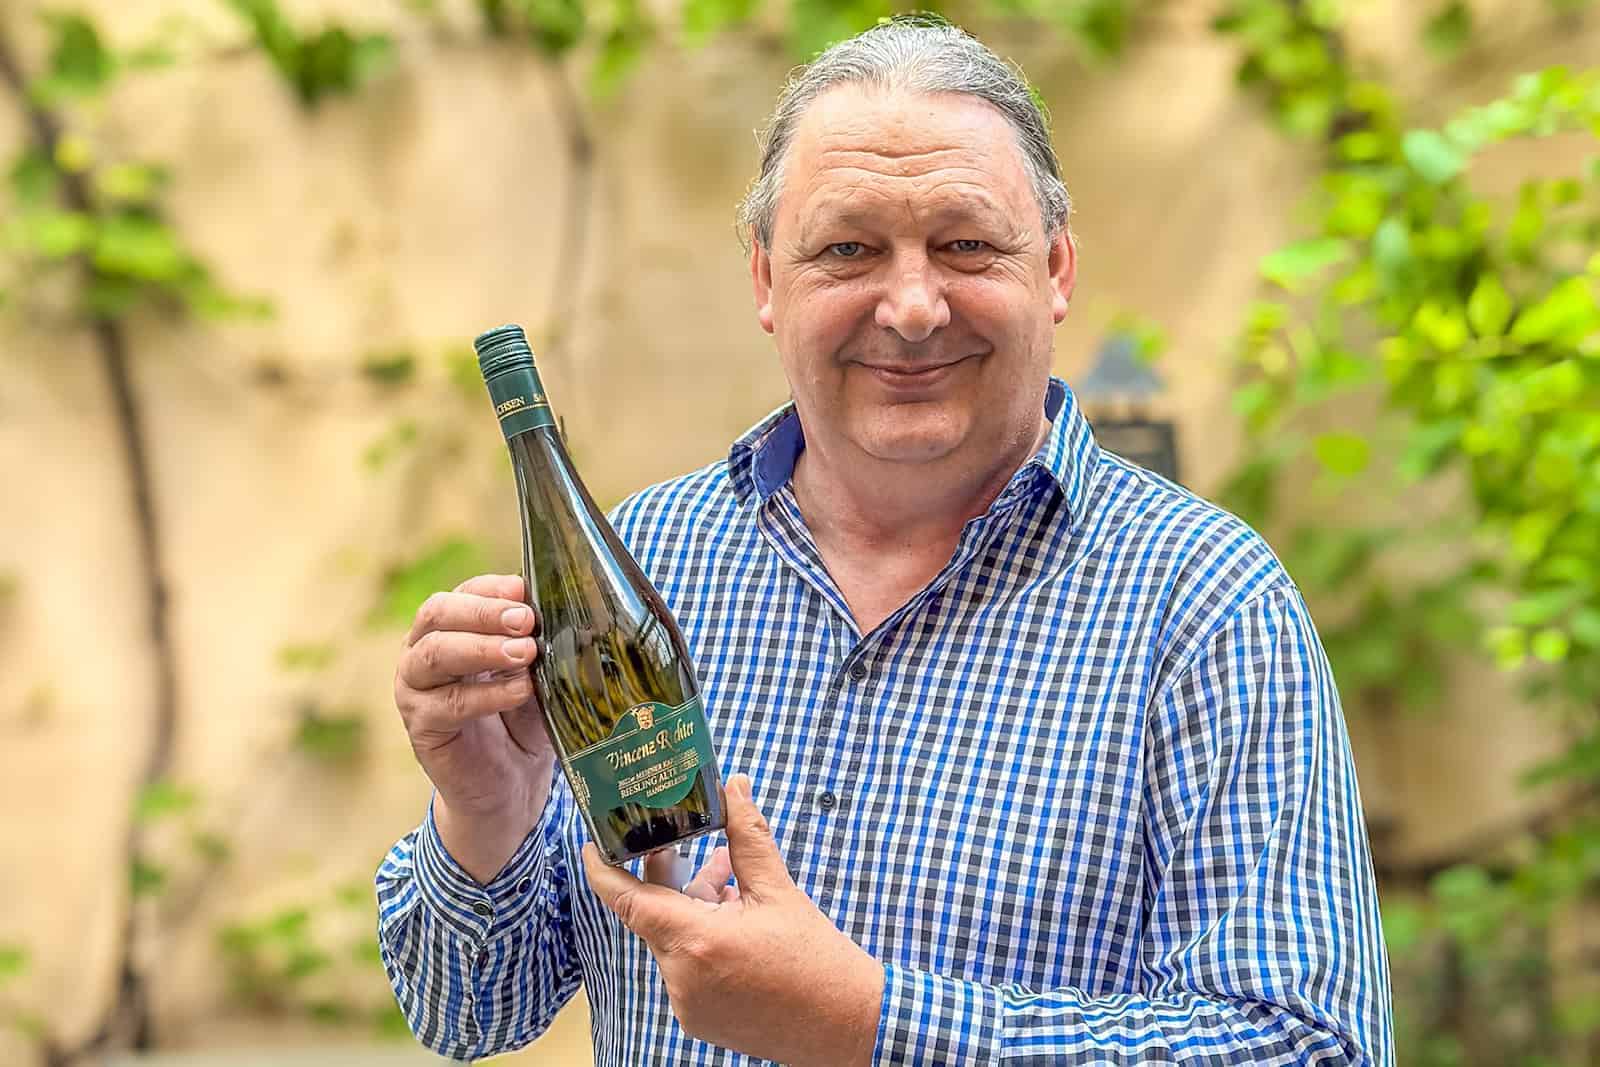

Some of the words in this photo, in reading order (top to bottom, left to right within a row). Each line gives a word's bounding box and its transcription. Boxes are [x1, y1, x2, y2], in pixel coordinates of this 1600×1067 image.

[606, 741, 656, 770] Vincenz
[656, 718, 694, 751] Rchter
[621, 775, 657, 798] RIESLING
